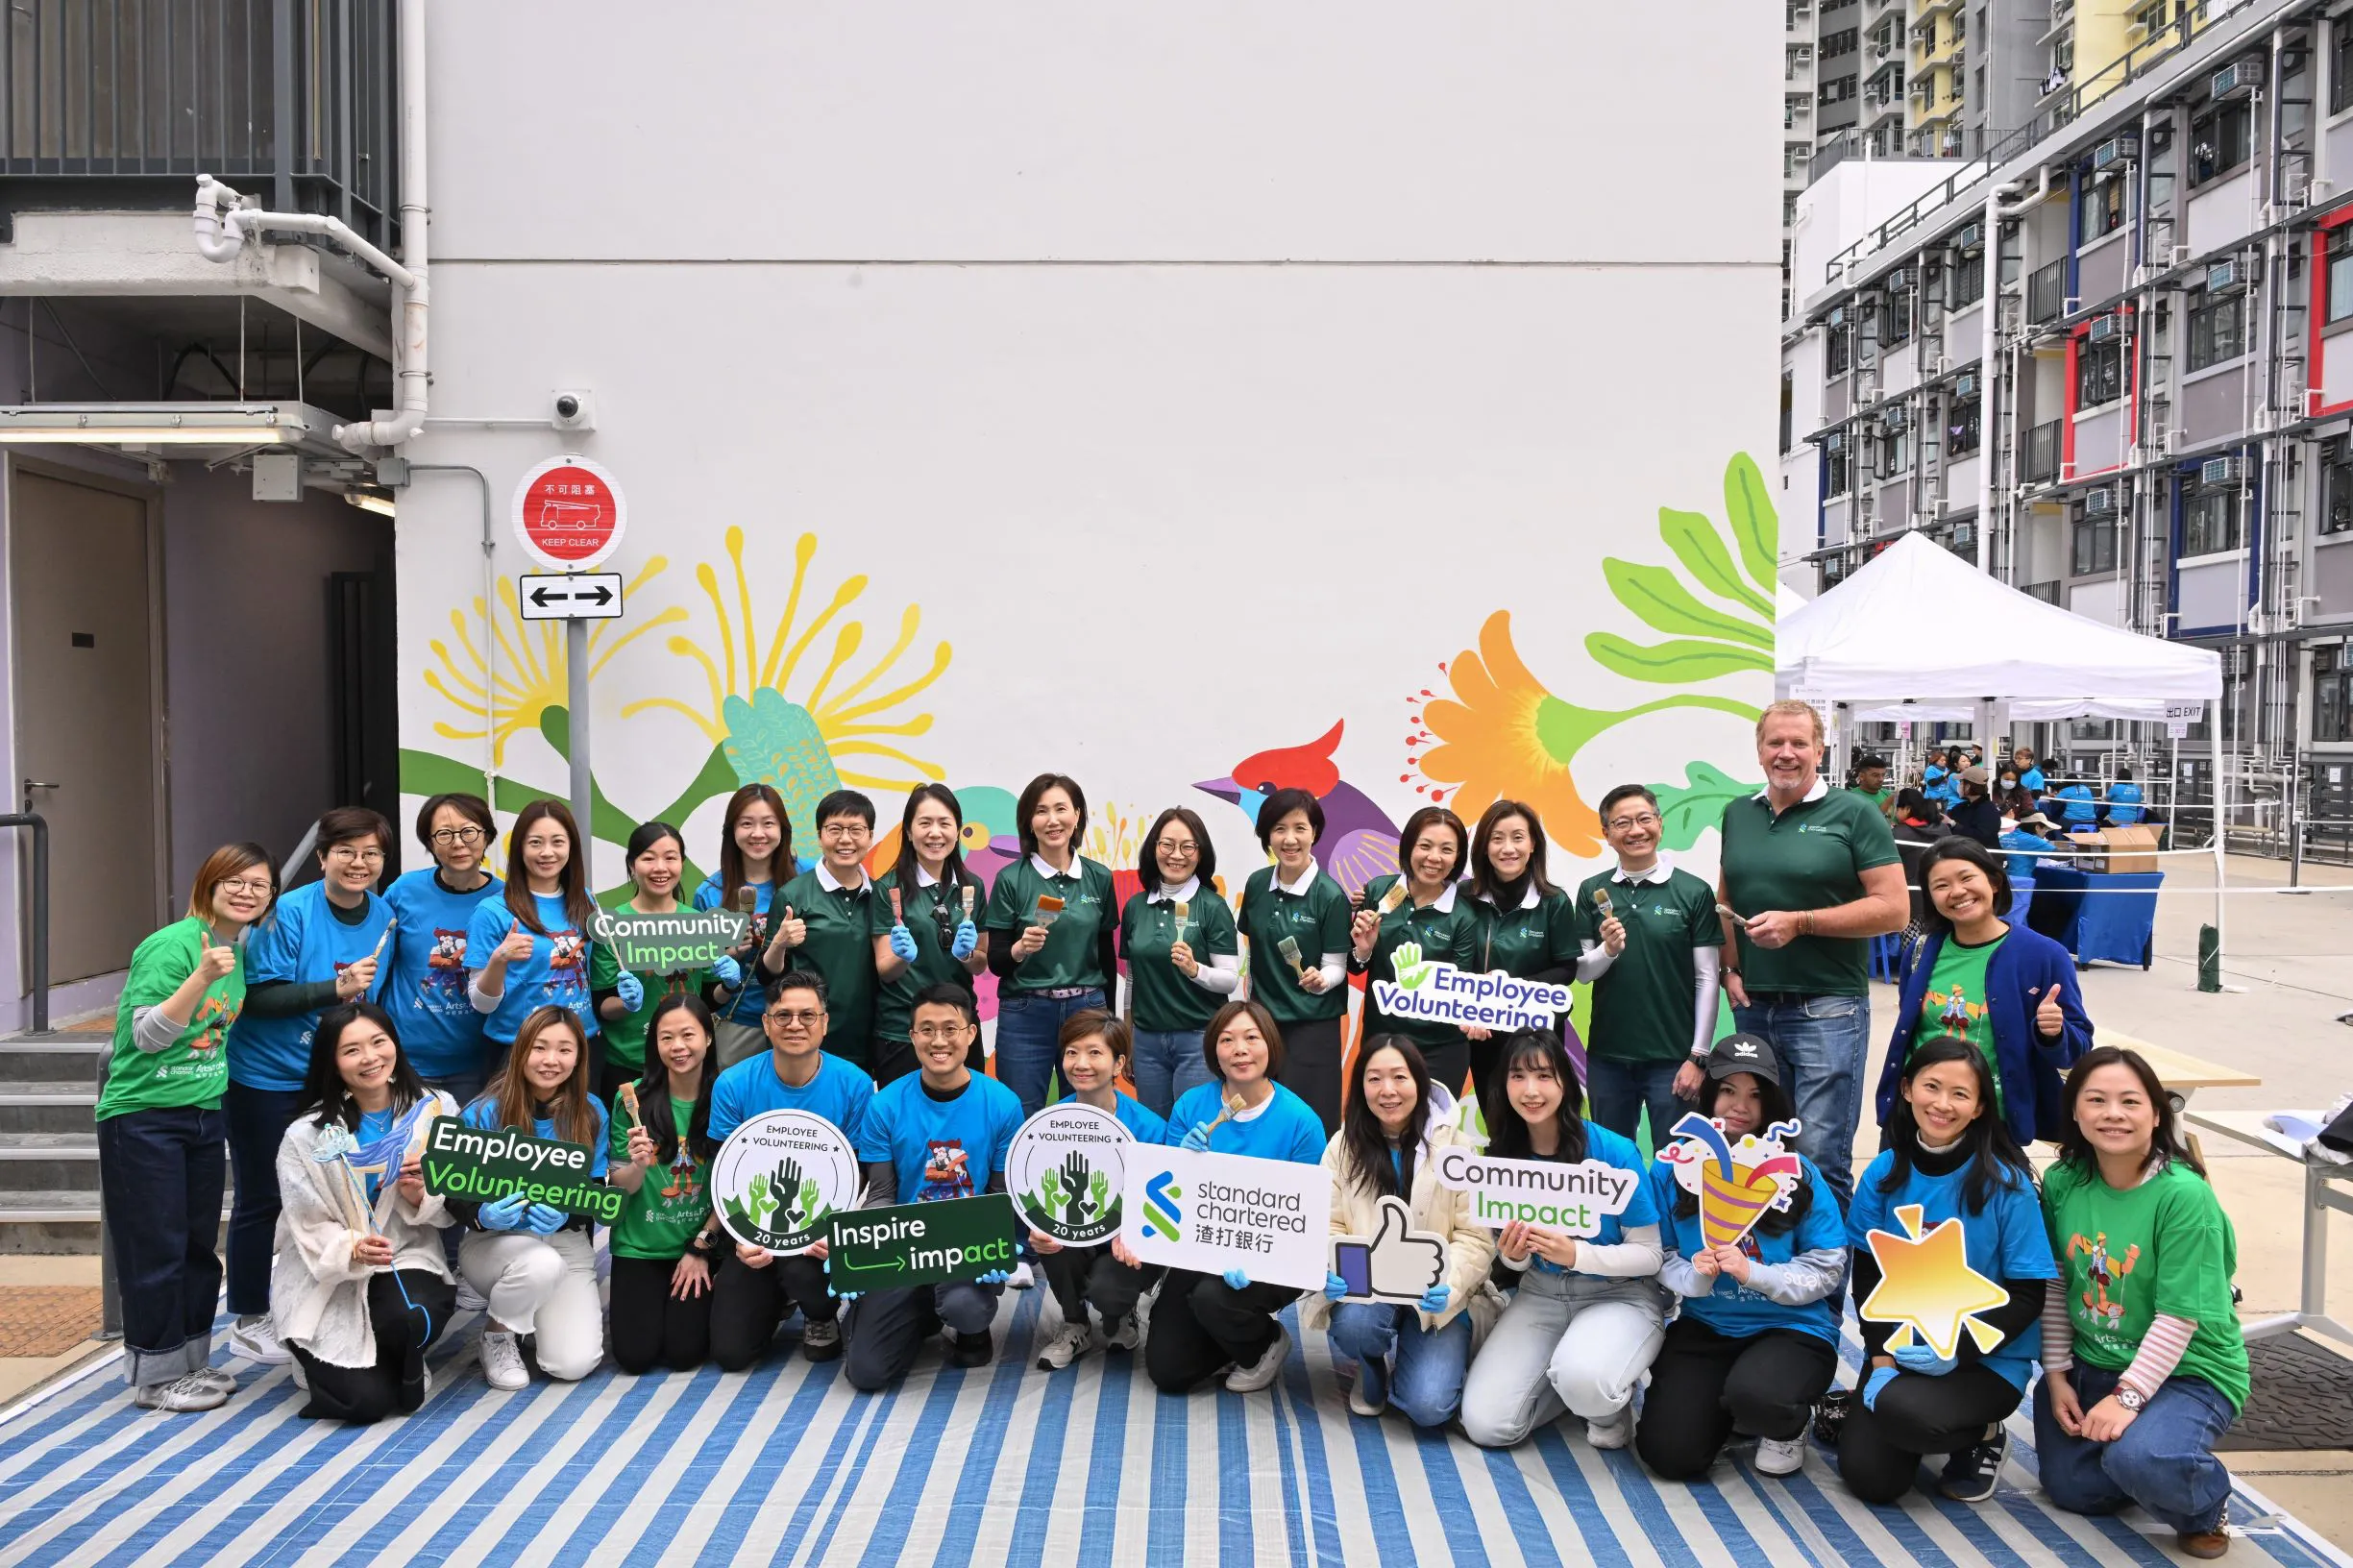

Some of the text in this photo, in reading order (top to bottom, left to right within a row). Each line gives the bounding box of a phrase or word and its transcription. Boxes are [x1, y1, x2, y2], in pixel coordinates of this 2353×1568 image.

[545, 484, 596, 496] 不可阻塞
[542, 538, 600, 547] KEEP CLEAR
[2166, 706, 2201, 718] 出口 EXIT
[594, 913, 744, 940] Community
[626, 941, 719, 968] Impact
[1434, 968, 1567, 1008] Employee
[766, 1124, 819, 1138] EMPLOYEE
[1039, 1133, 1112, 1143] VOLUNTEERING
[1050, 1119, 1099, 1130] EMPLOYEE
[433, 1122, 586, 1171] Employee
[752, 1137, 828, 1152] VOLUNTEERING
[428, 1160, 623, 1220] Volunteering
[1442, 1154, 1629, 1206] Community
[1198, 1180, 1301, 1212] standard
[1478, 1190, 1591, 1228] Impact
[1052, 1223, 1106, 1239] 20 years
[1196, 1202, 1306, 1234] chartered
[754, 1231, 811, 1249] 20 years
[833, 1215, 926, 1249] Inspire
[1195, 1223, 1274, 1254] 渣打銀行
[910, 1237, 1010, 1273] impact
